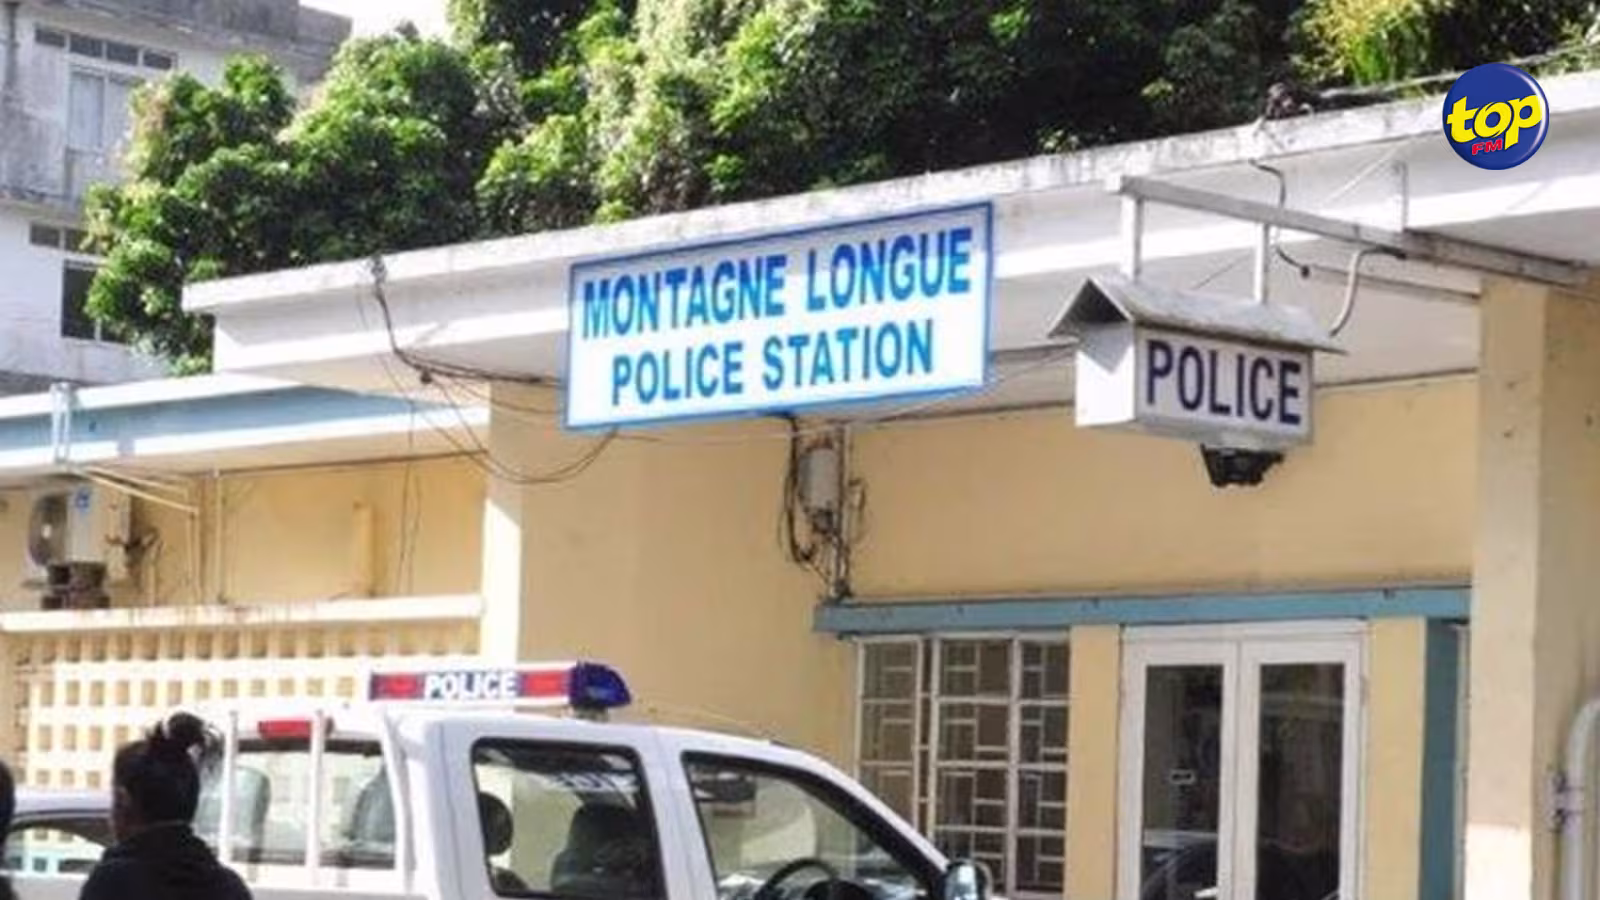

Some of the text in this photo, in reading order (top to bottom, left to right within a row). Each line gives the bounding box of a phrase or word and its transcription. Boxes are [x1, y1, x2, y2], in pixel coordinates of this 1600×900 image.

[582, 227, 972, 340] MONTAGNE LONGUE
[612, 318, 933, 407] POLICE STATION
[1146, 339, 1301, 425] POLICE
[423, 671, 519, 699] POLICE
